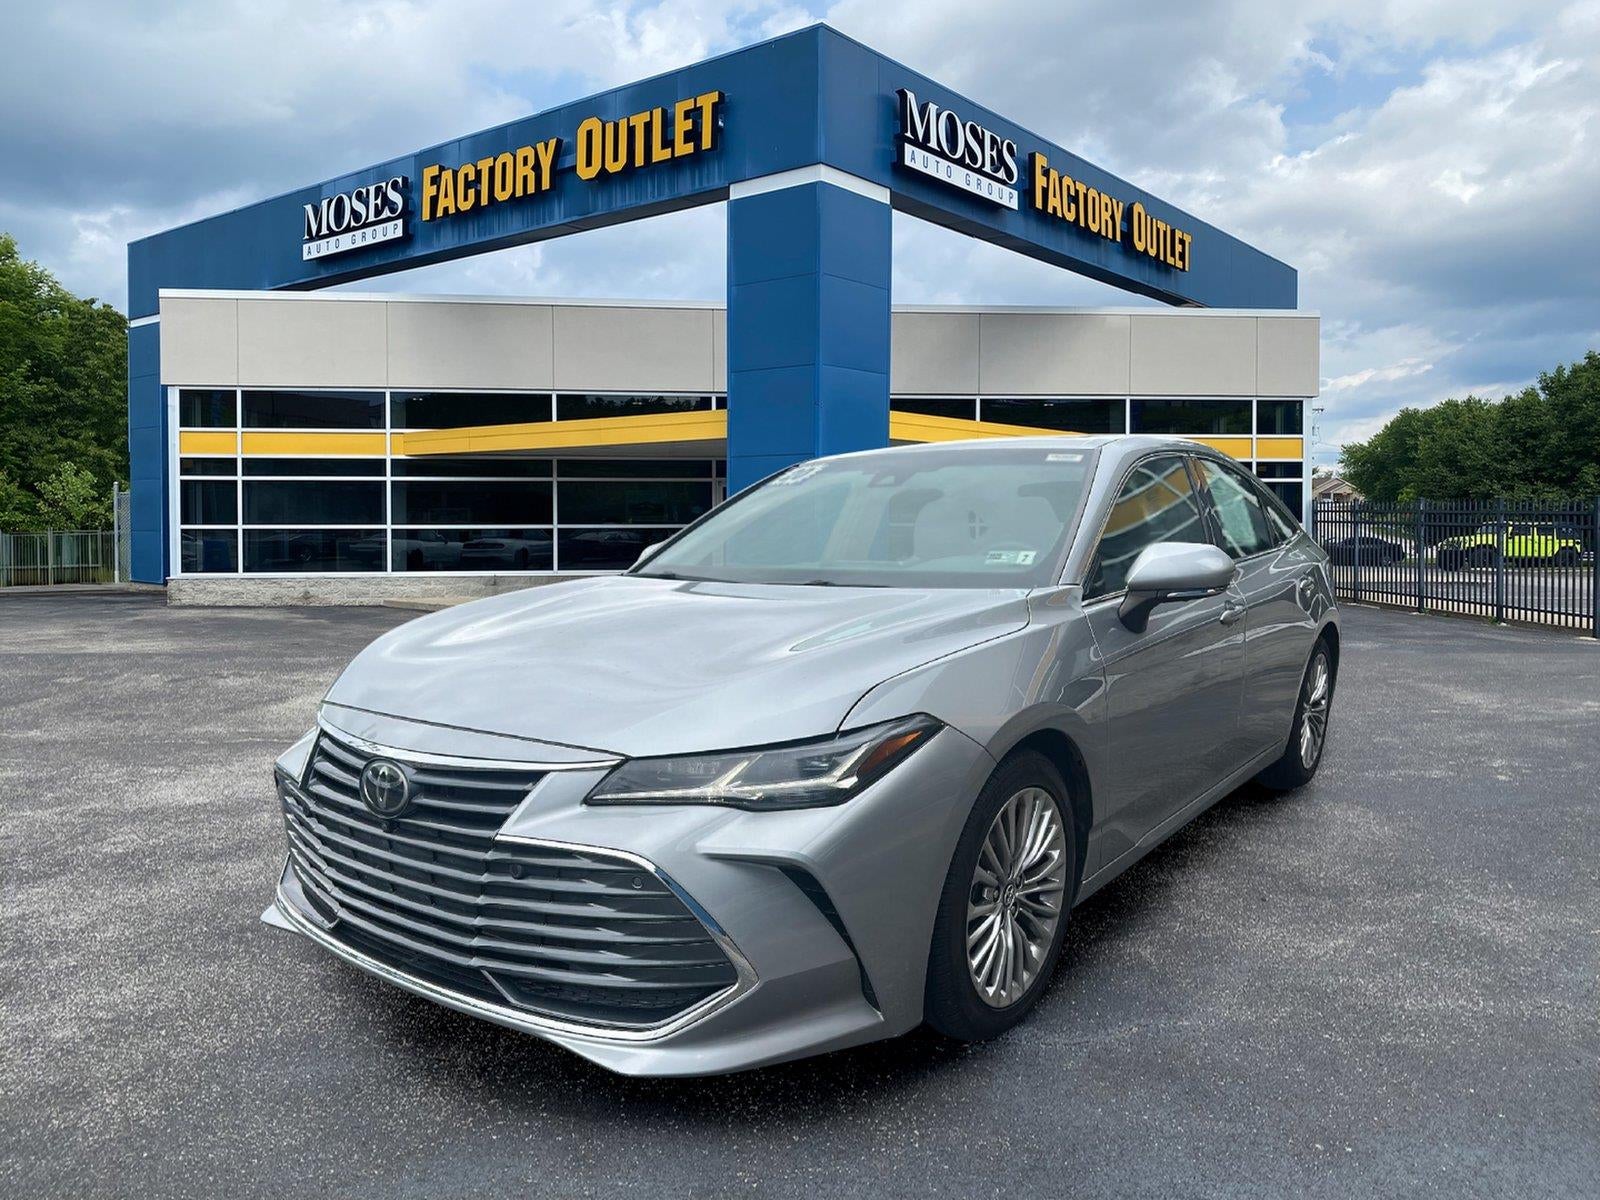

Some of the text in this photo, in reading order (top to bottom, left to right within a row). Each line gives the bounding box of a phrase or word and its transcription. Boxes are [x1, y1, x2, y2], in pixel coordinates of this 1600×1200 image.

[421, 91, 719, 220] FACTORY OUTLET
[904, 88, 1017, 184] MOSES
[303, 177, 403, 239] MOSES
[909, 149, 1015, 204] AUTO GROUP
[1034, 152, 1192, 272] FACTORY OUTLET
[306, 223, 399, 256] AUTO GROUP
